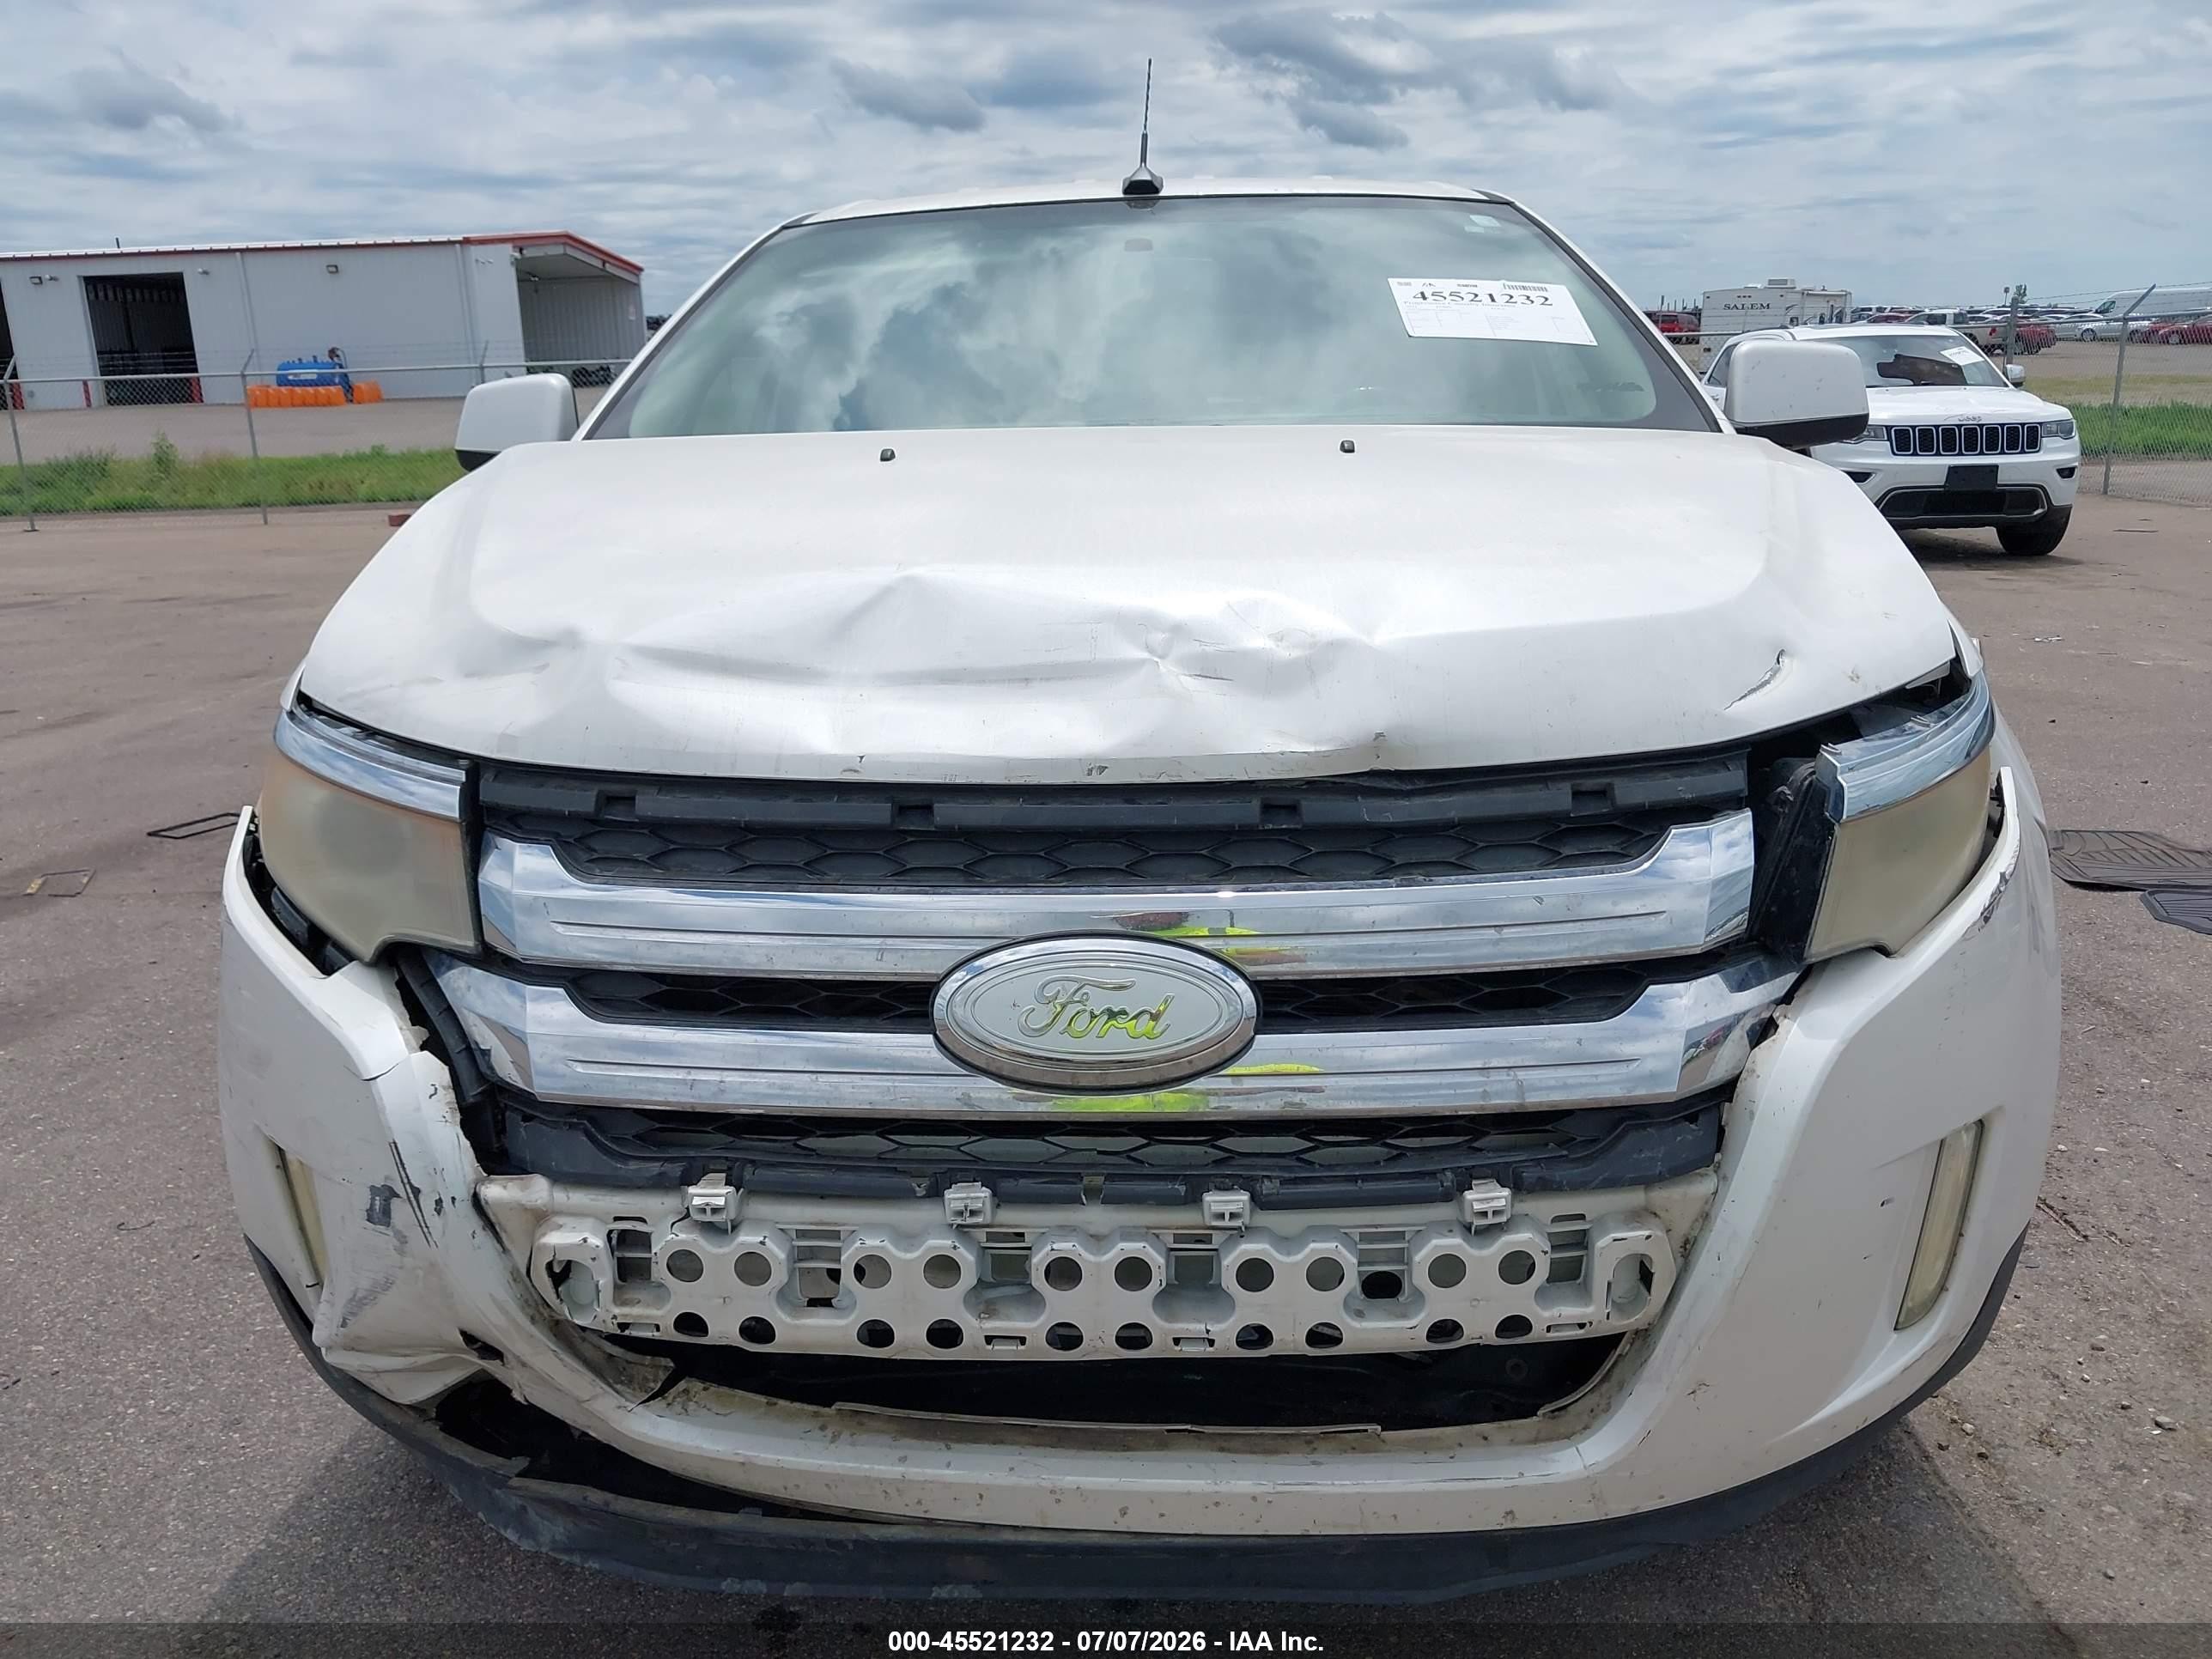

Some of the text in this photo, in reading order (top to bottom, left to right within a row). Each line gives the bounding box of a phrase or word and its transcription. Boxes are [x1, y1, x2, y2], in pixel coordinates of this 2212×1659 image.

[1413, 290, 1553, 307] 45521232
[1723, 302, 1771, 311] SALEM
[1017, 974, 1175, 1040] Ford
